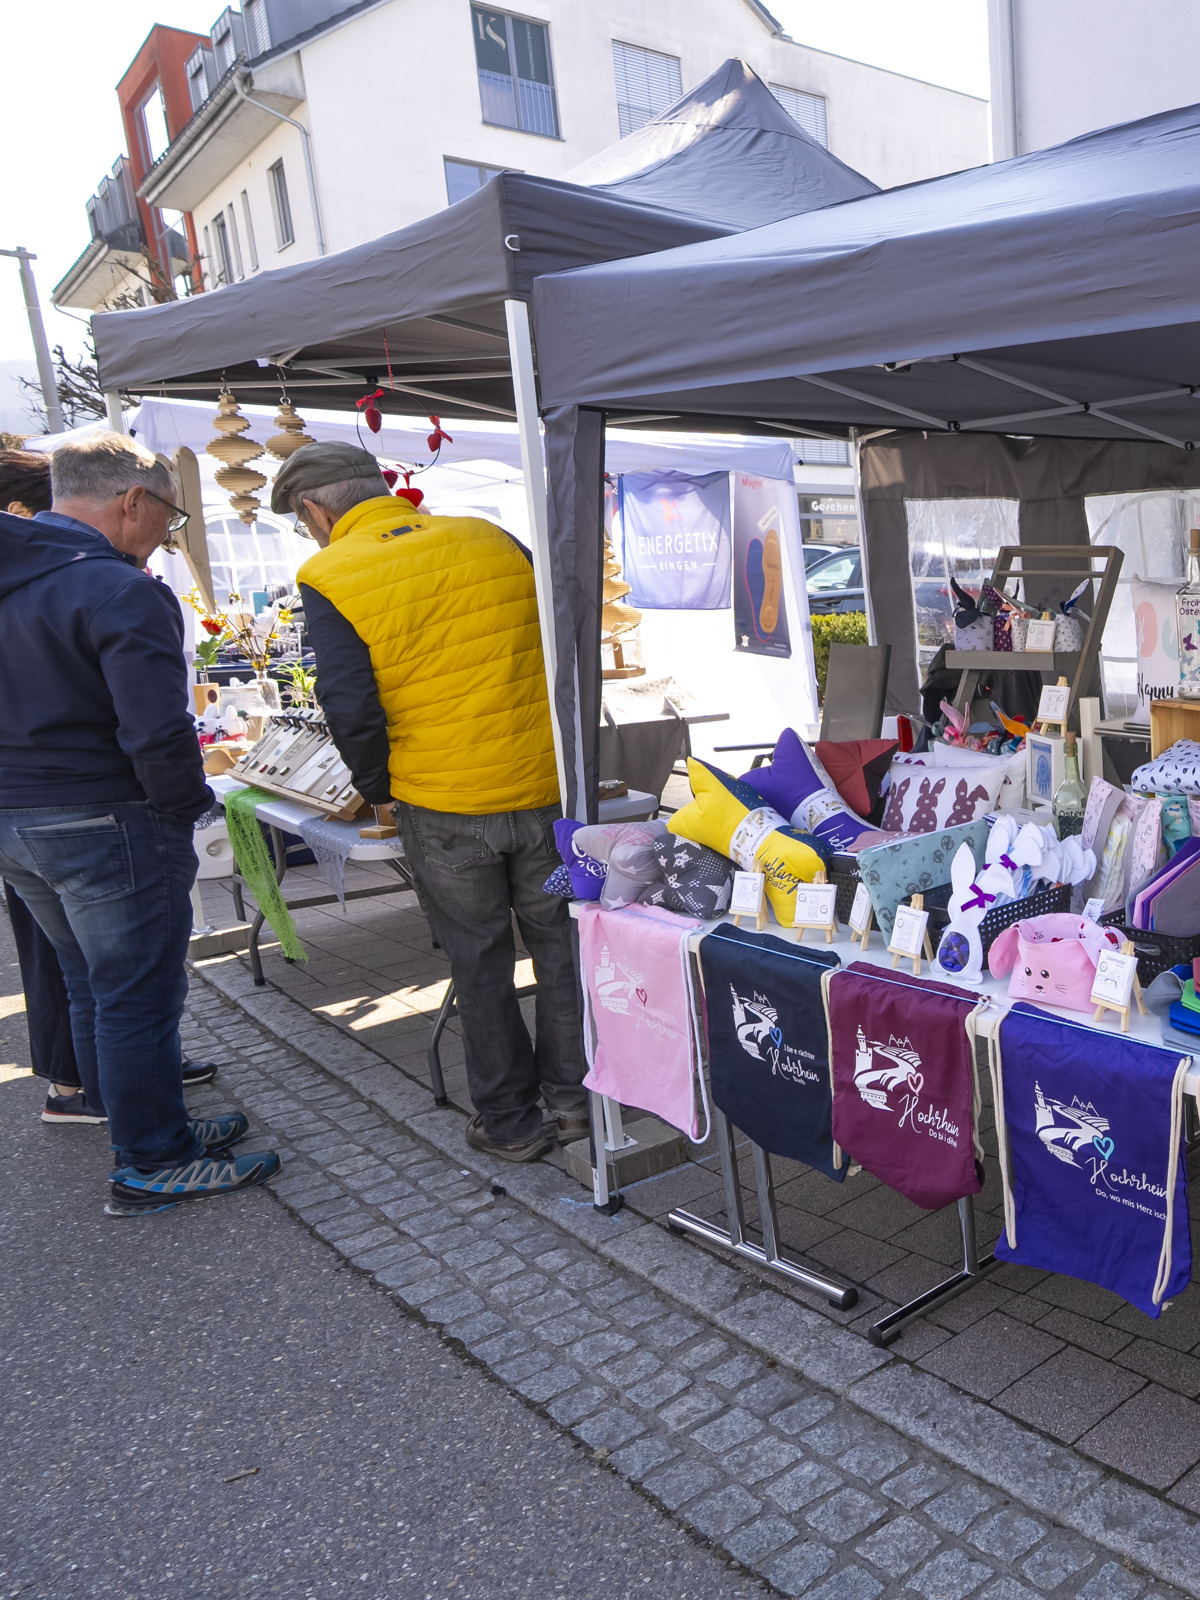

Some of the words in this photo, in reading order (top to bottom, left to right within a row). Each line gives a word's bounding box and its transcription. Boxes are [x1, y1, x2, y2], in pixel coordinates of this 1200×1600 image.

[638, 531, 718, 556] ENERGETIX
[659, 560, 698, 571] BINGEN
[767, 875, 787, 891] Platz
[766, 1046, 820, 1082] Hochrhein
[898, 1093, 960, 1137] Hochrhein
[929, 1128, 938, 1139] Do
[1095, 1188, 1109, 1199] Do,
[1109, 1193, 1121, 1203] wo
[1122, 1198, 1135, 1208] mis
[1136, 1202, 1153, 1216] Herz
